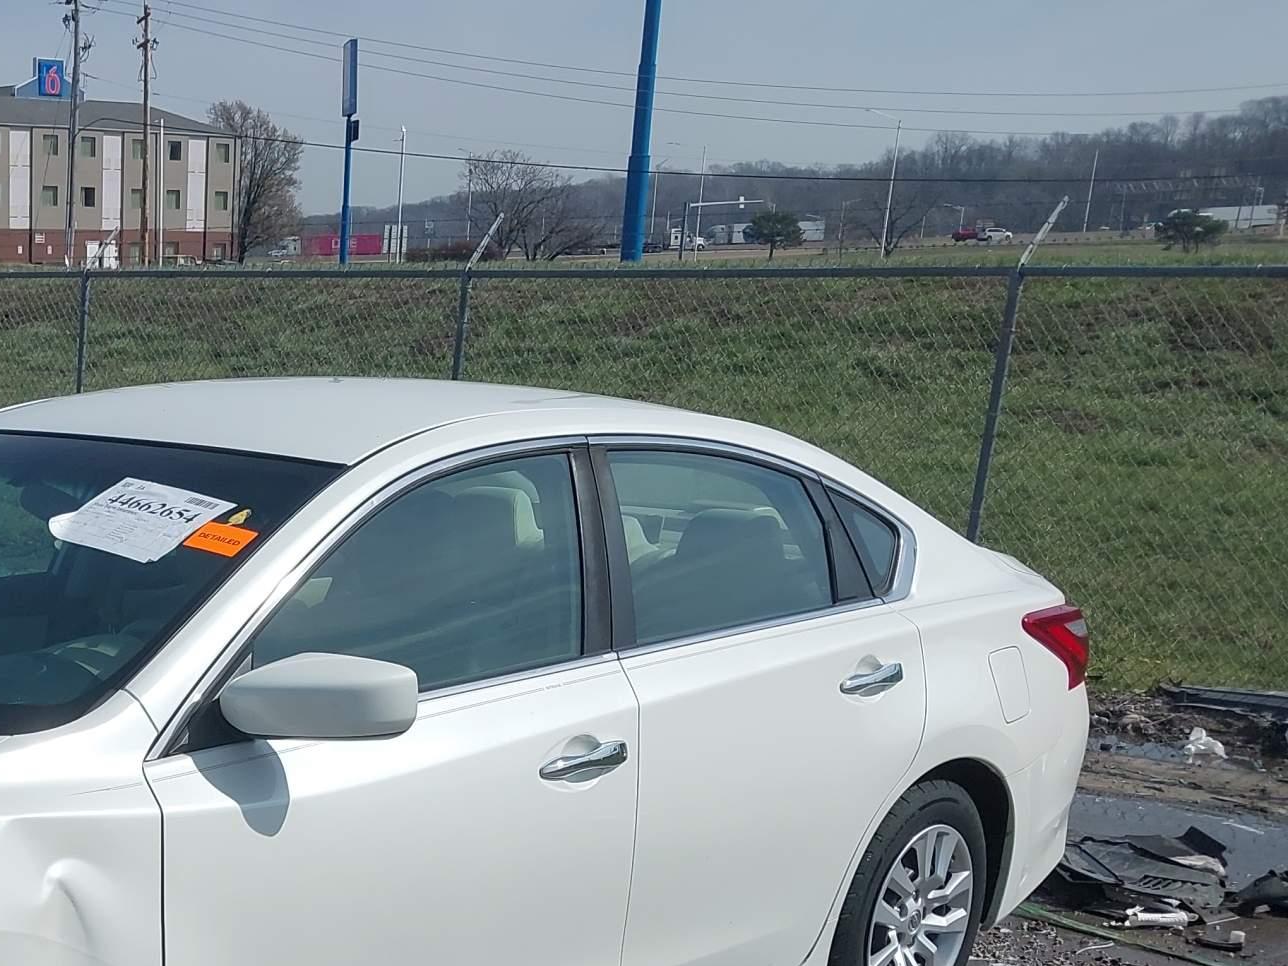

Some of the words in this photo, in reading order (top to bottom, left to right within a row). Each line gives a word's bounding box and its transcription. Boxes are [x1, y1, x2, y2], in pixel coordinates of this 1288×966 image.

[45, 66, 61, 95] 6
[108, 493, 202, 523] 44662654
[198, 532, 241, 546] DETAILED
